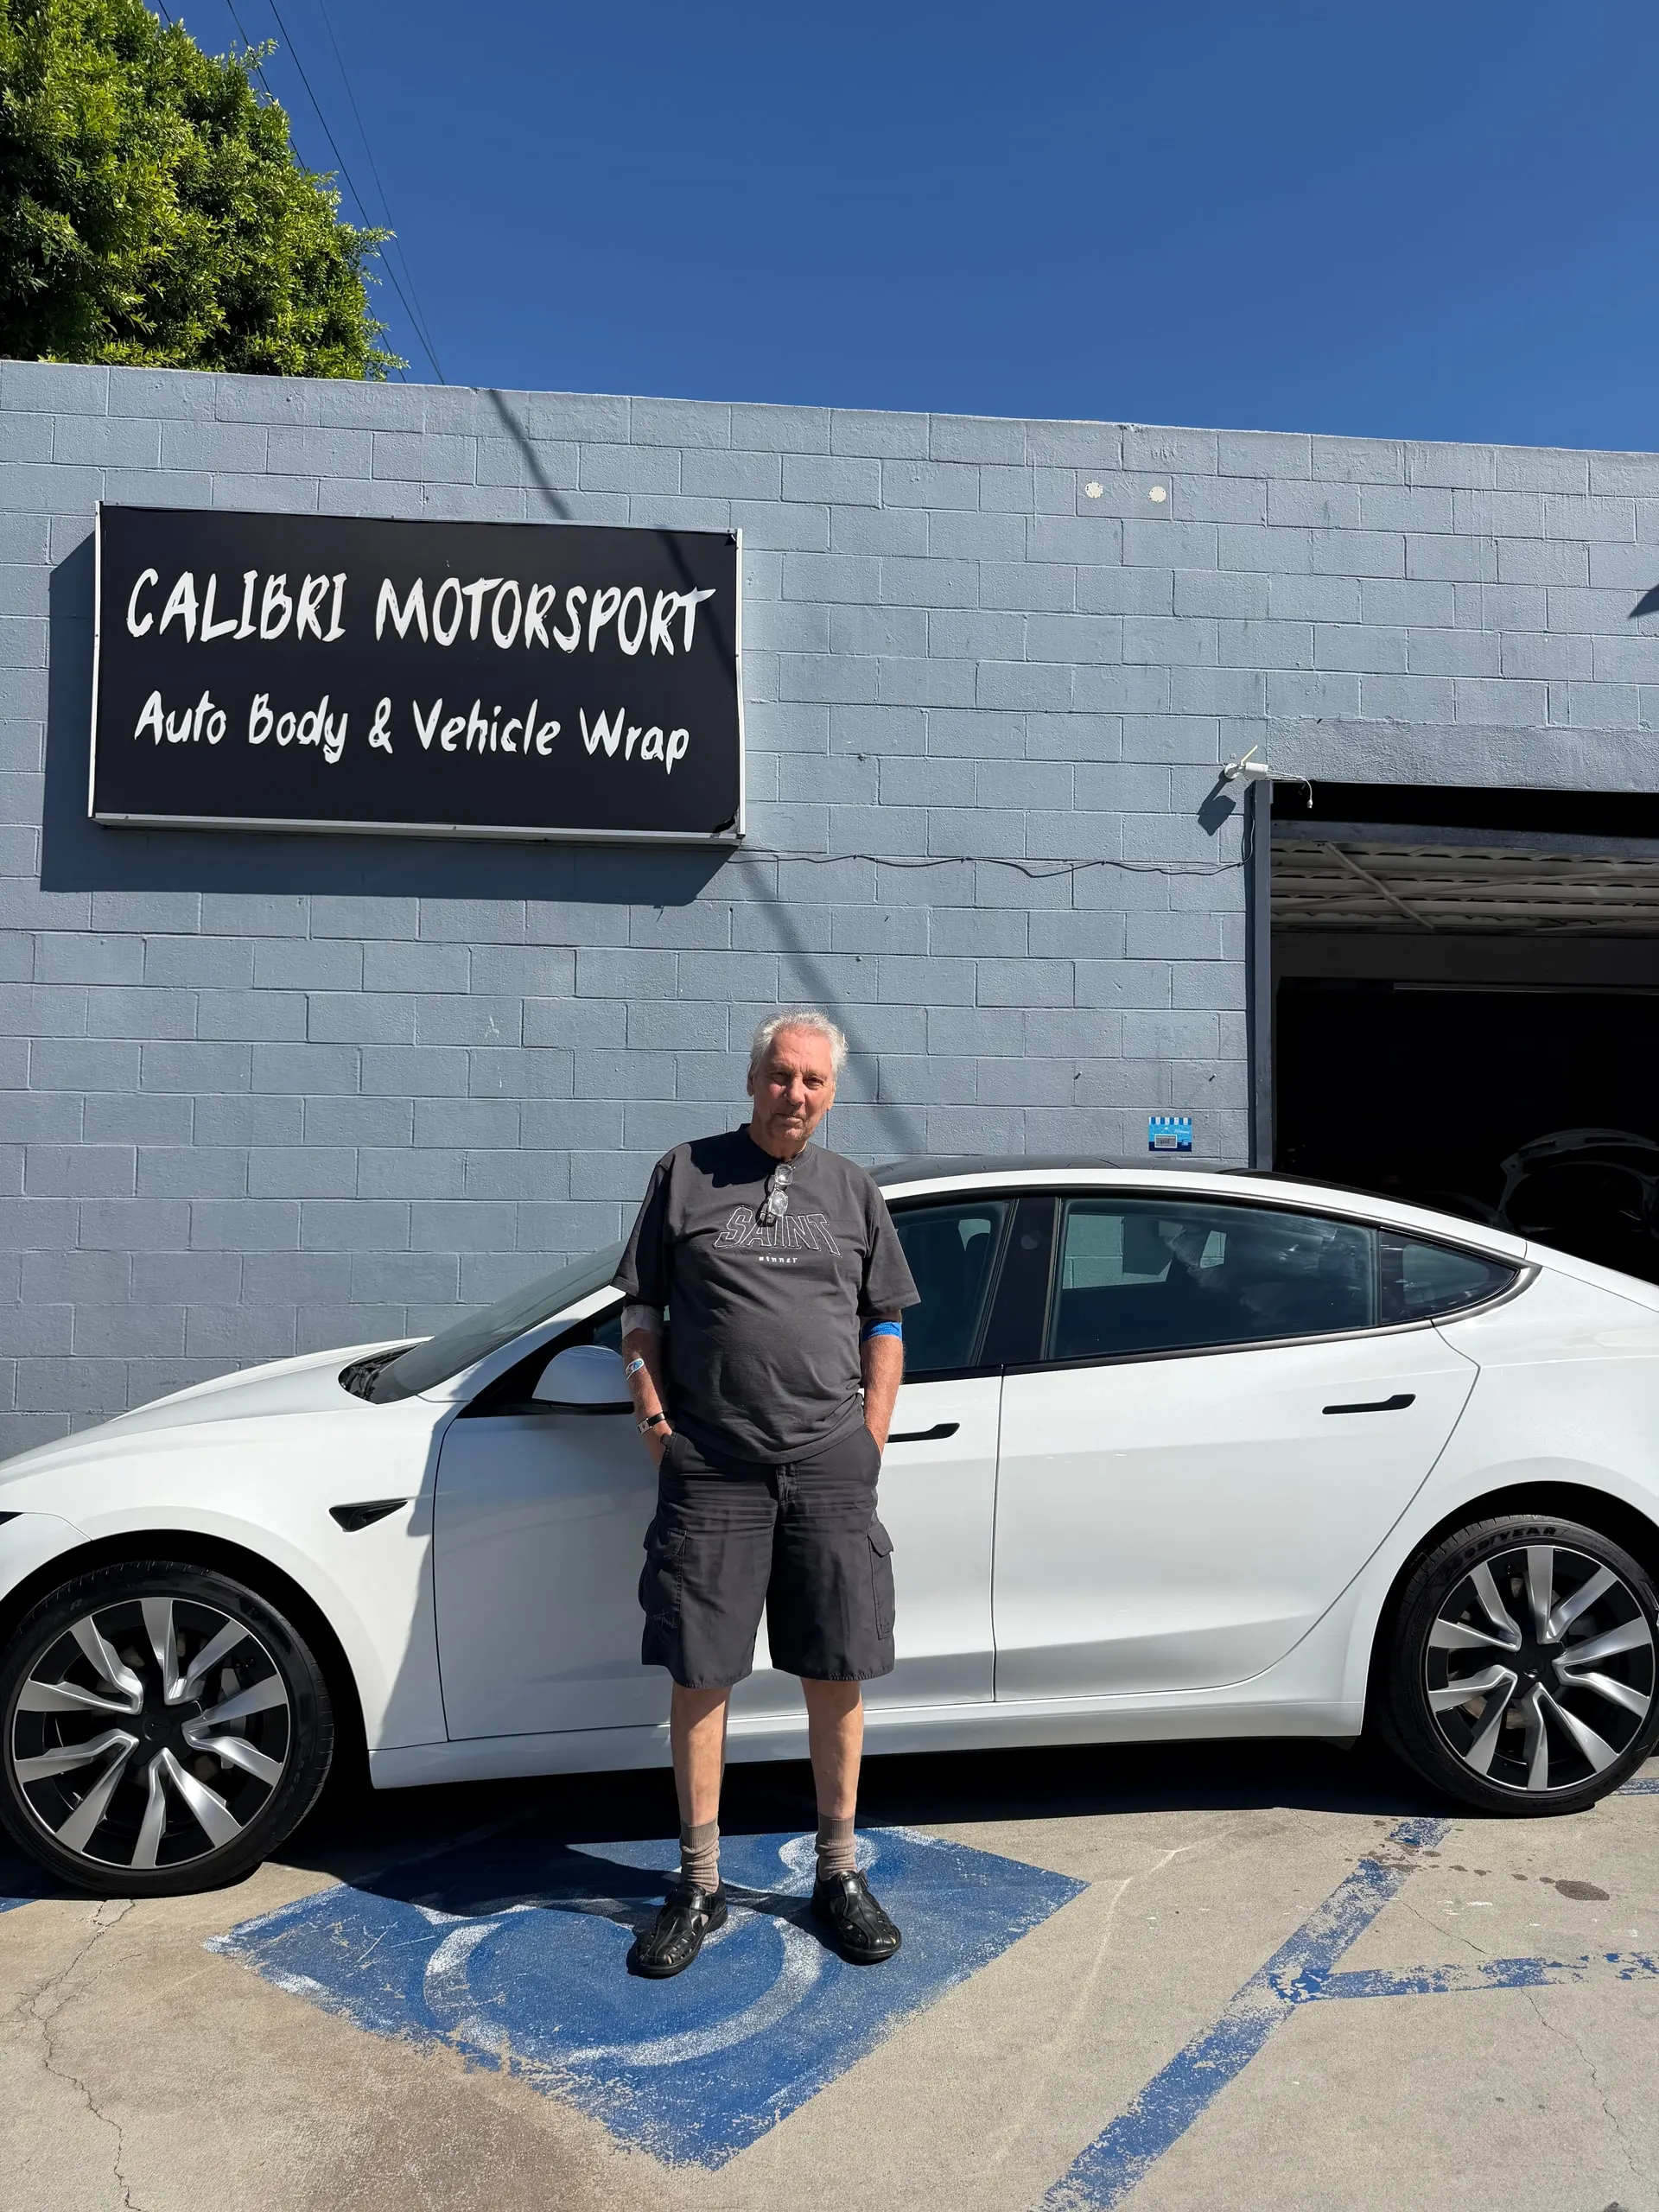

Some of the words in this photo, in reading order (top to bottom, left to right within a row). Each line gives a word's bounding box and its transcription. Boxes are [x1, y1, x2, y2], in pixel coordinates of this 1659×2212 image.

[125, 568, 347, 644] CALIBRI
[375, 576, 716, 657] MOTORSPORT
[134, 690, 227, 747] Auto
[248, 692, 347, 765] Body
[368, 696, 394, 755] &
[412, 698, 561, 758] Vehicle
[579, 707, 690, 775] Wrap
[713, 1205, 842, 1258] SAINT
